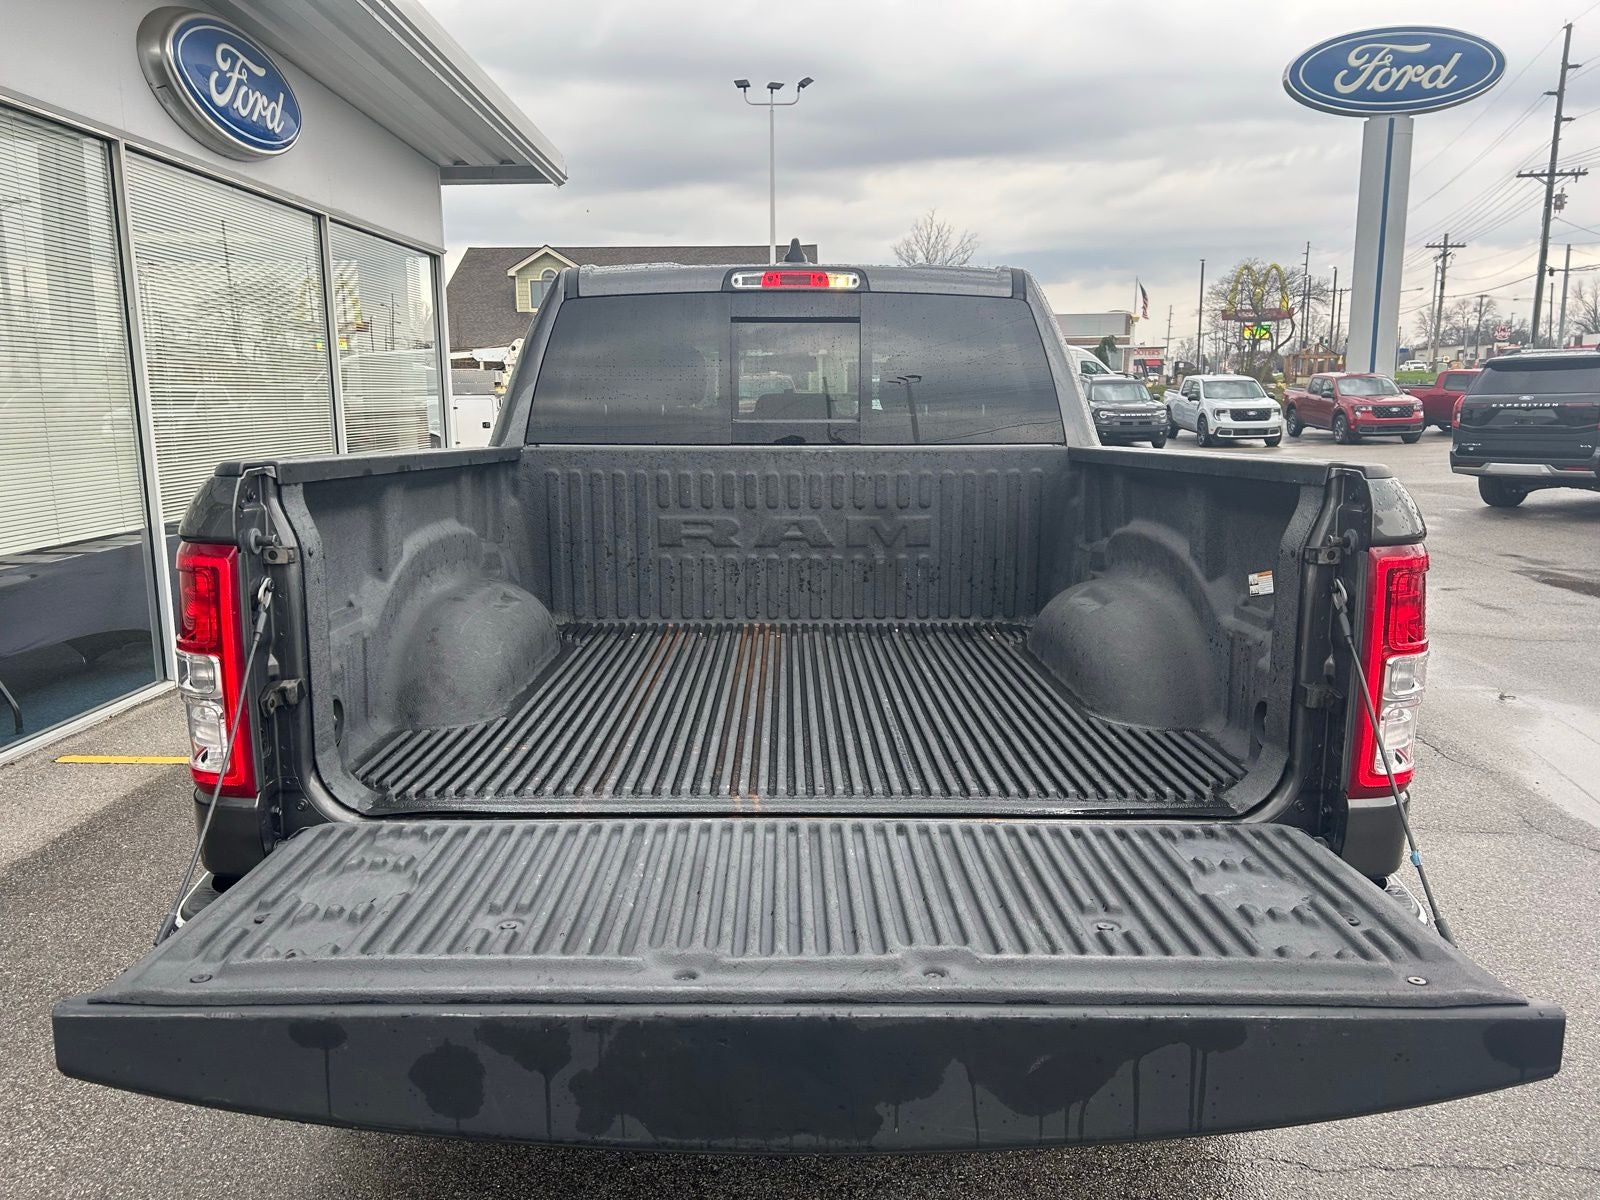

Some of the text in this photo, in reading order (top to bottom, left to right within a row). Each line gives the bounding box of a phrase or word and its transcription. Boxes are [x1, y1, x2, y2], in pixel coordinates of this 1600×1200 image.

[209, 43, 284, 133] Ford
[1334, 43, 1462, 94] Ford
[657, 515, 931, 548] RAM
